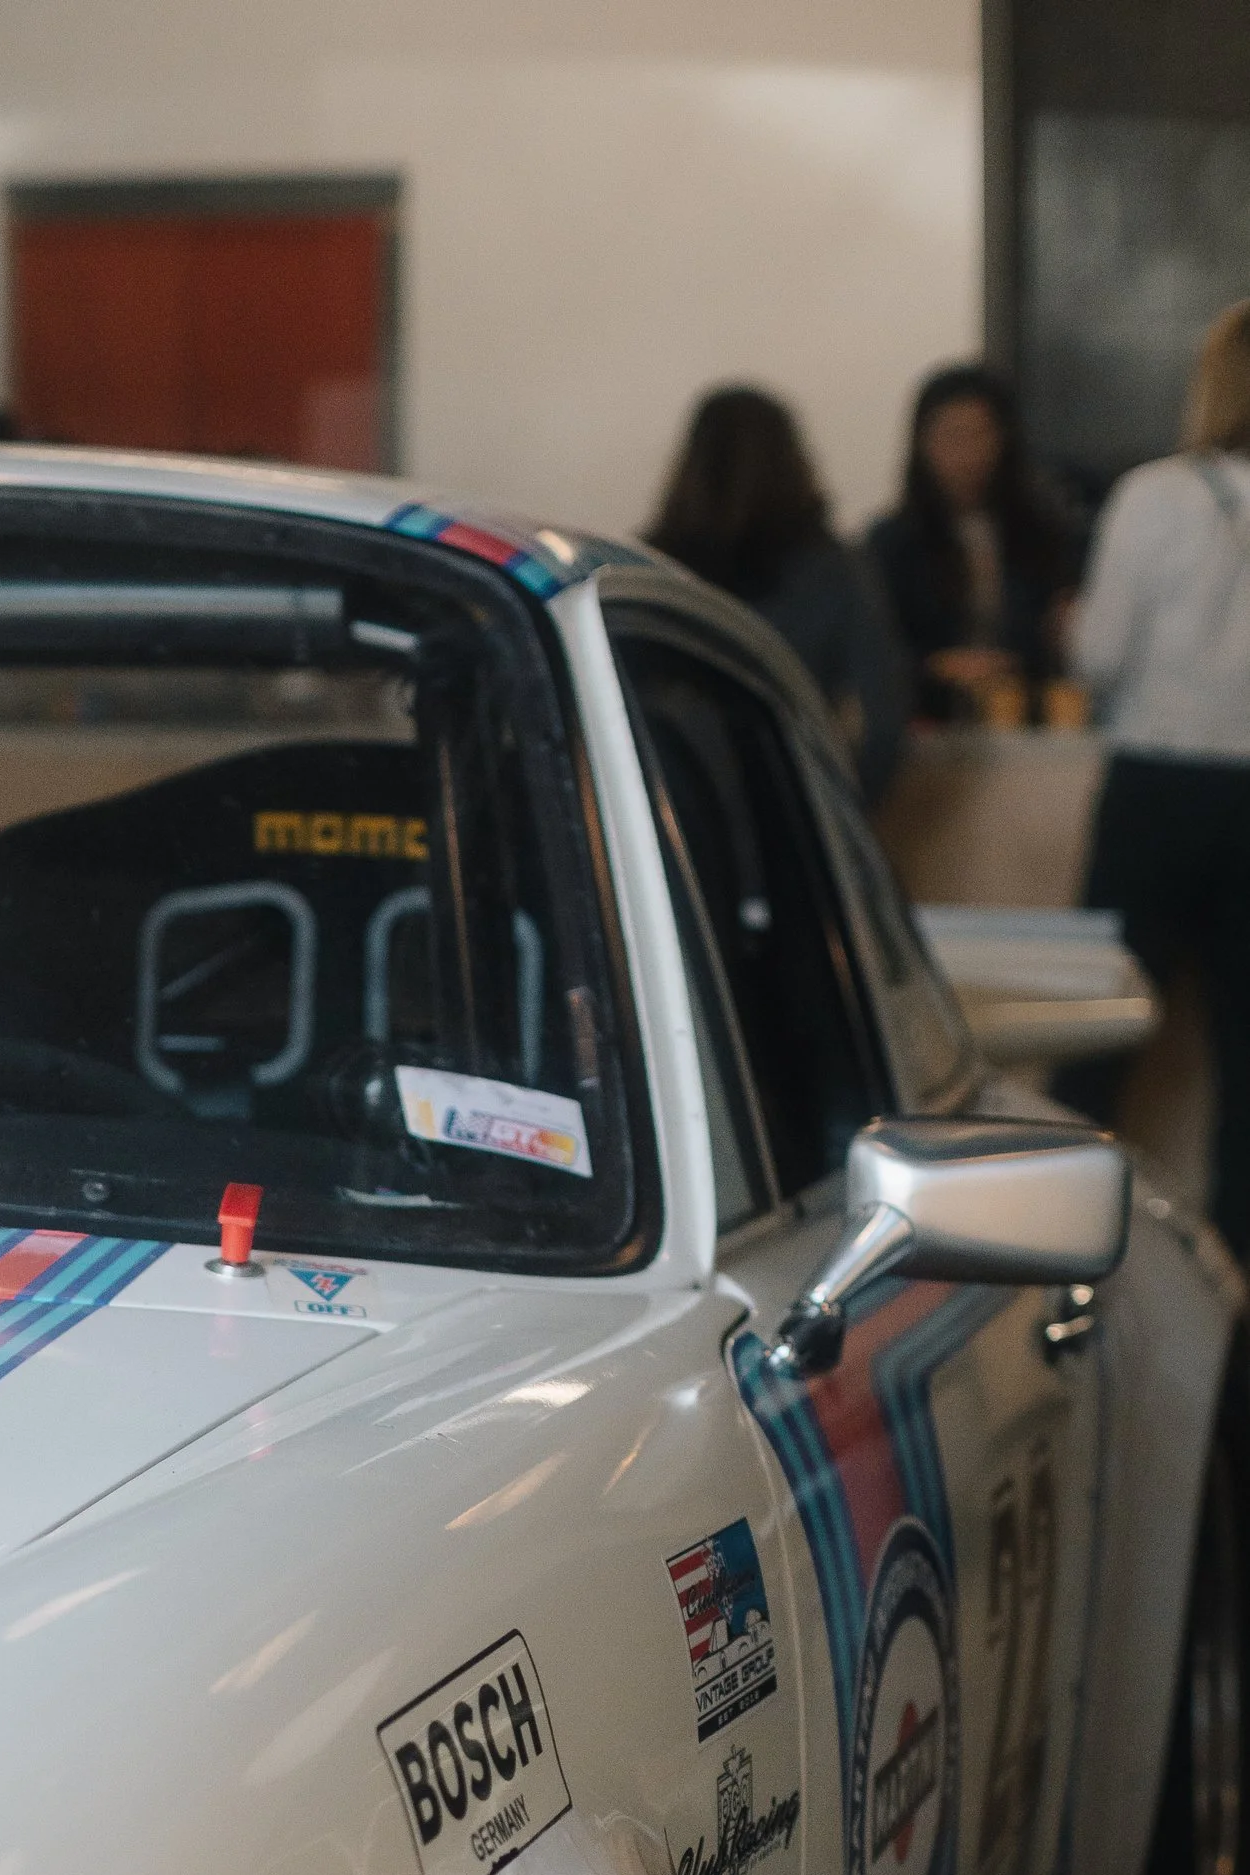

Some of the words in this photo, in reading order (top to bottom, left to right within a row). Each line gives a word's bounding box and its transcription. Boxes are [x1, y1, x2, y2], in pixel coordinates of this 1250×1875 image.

[695, 1672, 739, 1712] VINTAGE
[741, 1646, 775, 1684] GROUP
[396, 1662, 543, 1846] BOSCH
[470, 1795, 532, 1861] GERMANY
